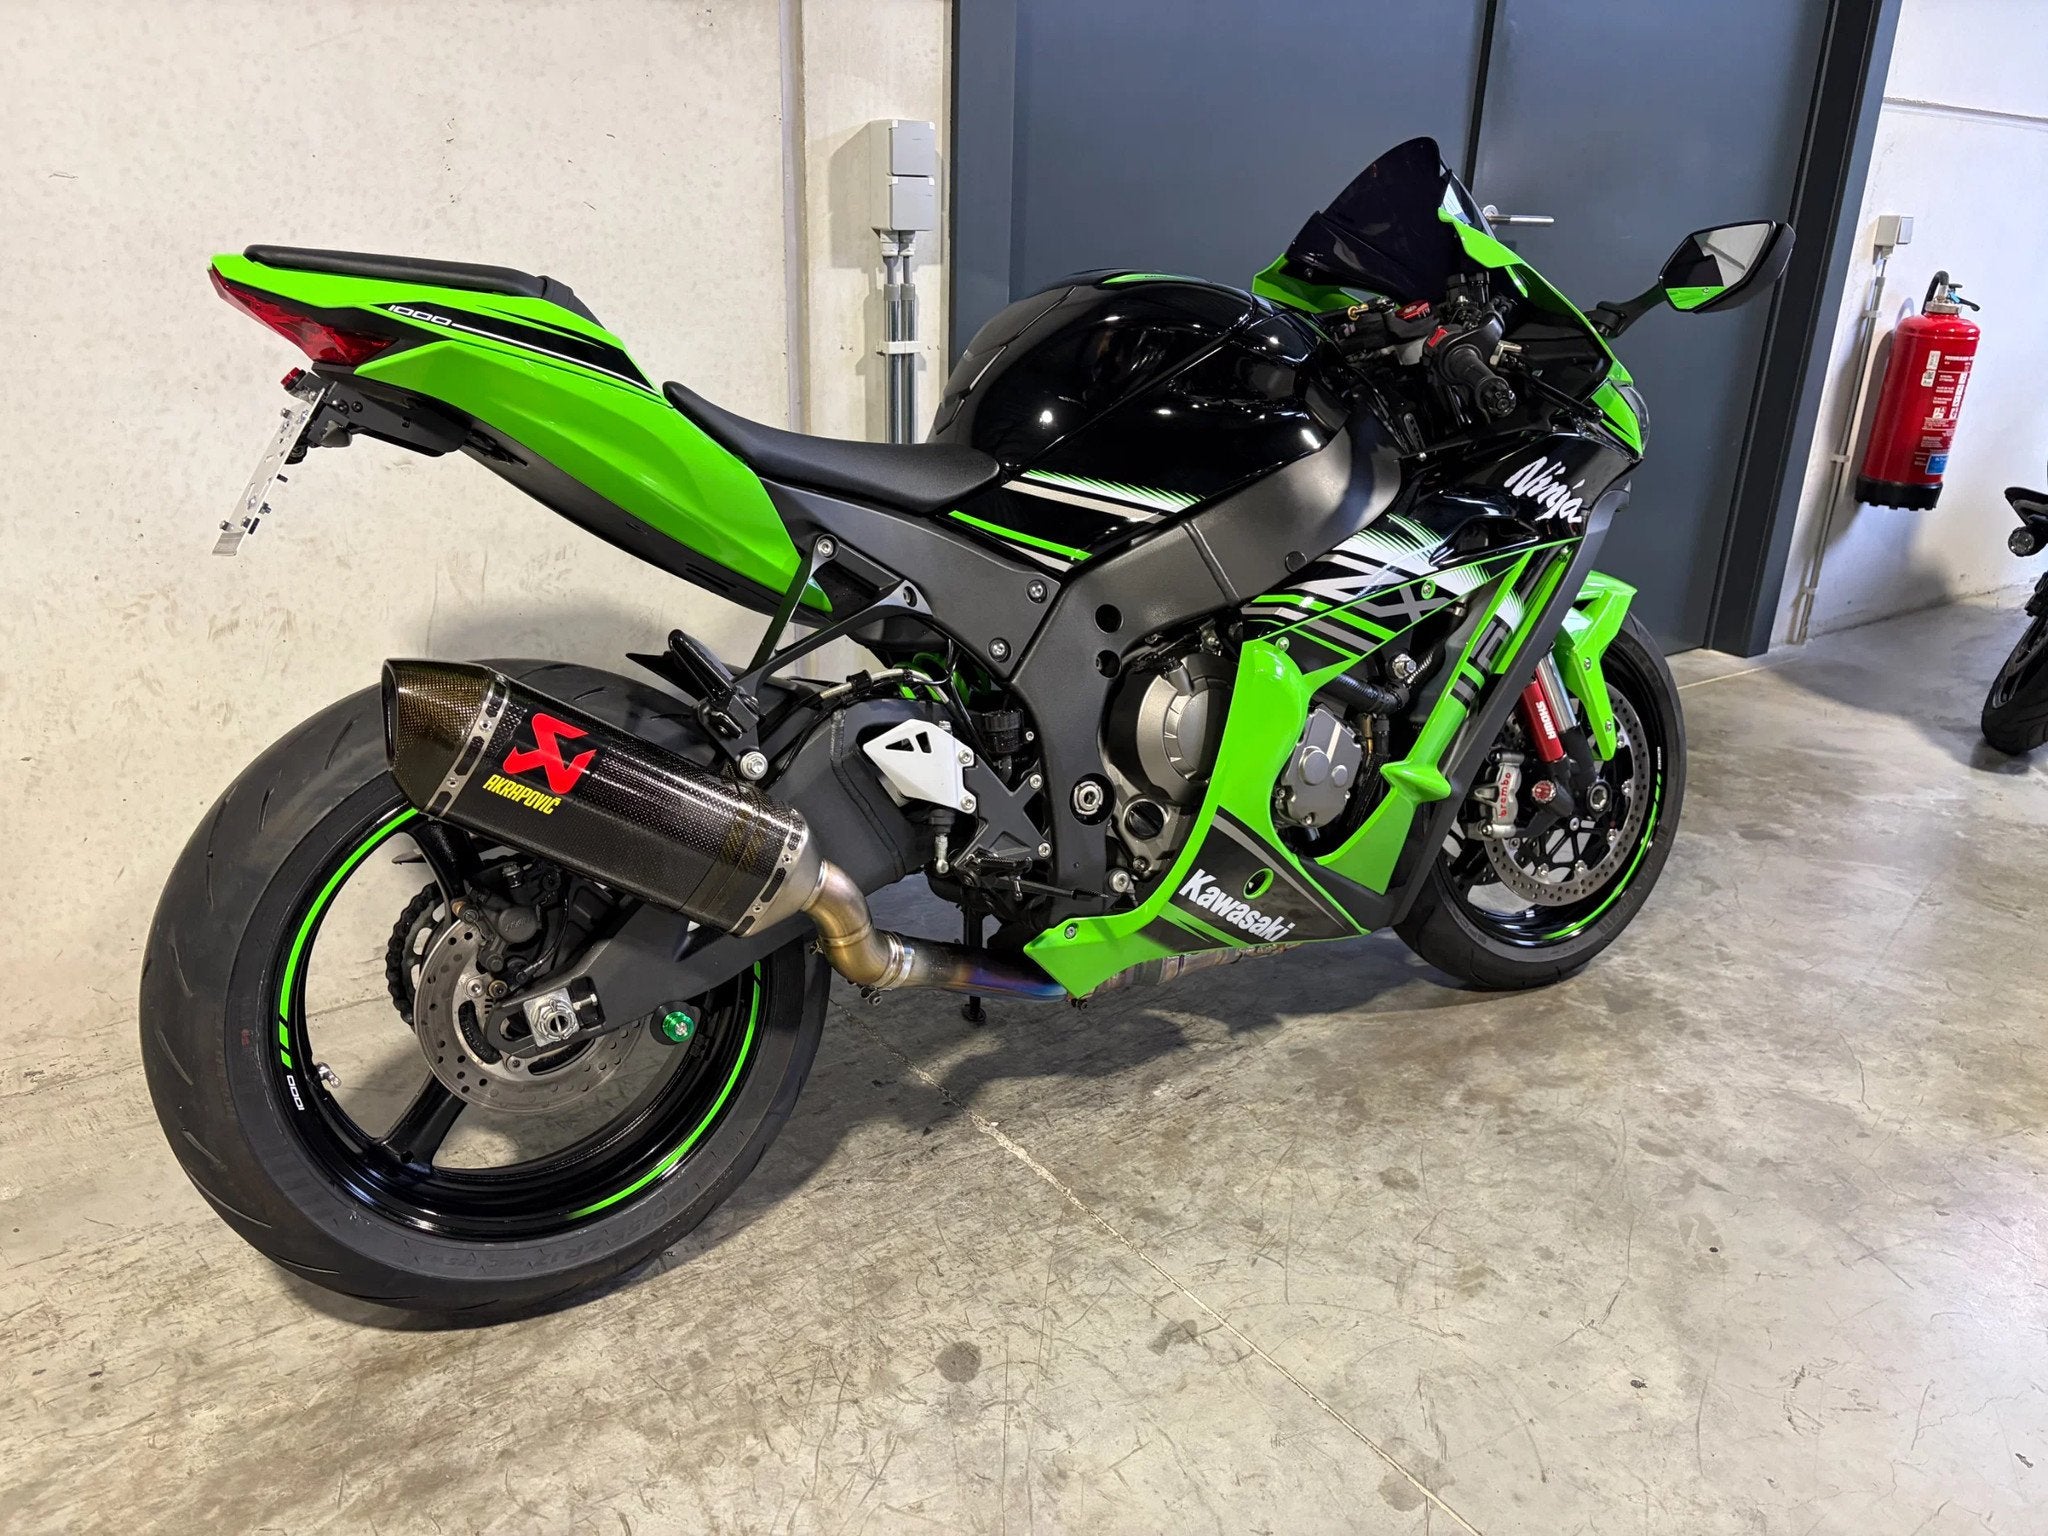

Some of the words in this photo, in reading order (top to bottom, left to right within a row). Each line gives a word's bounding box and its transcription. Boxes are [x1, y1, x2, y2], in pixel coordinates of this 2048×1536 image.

[388, 304, 452, 326] 1000
[1504, 456, 1585, 523] Ninja
[1536, 701, 1556, 739] SHOWA
[1499, 772, 1512, 817] brembo
[1178, 868, 1296, 942] Kawasaki
[286, 1074, 305, 1110] 1000
